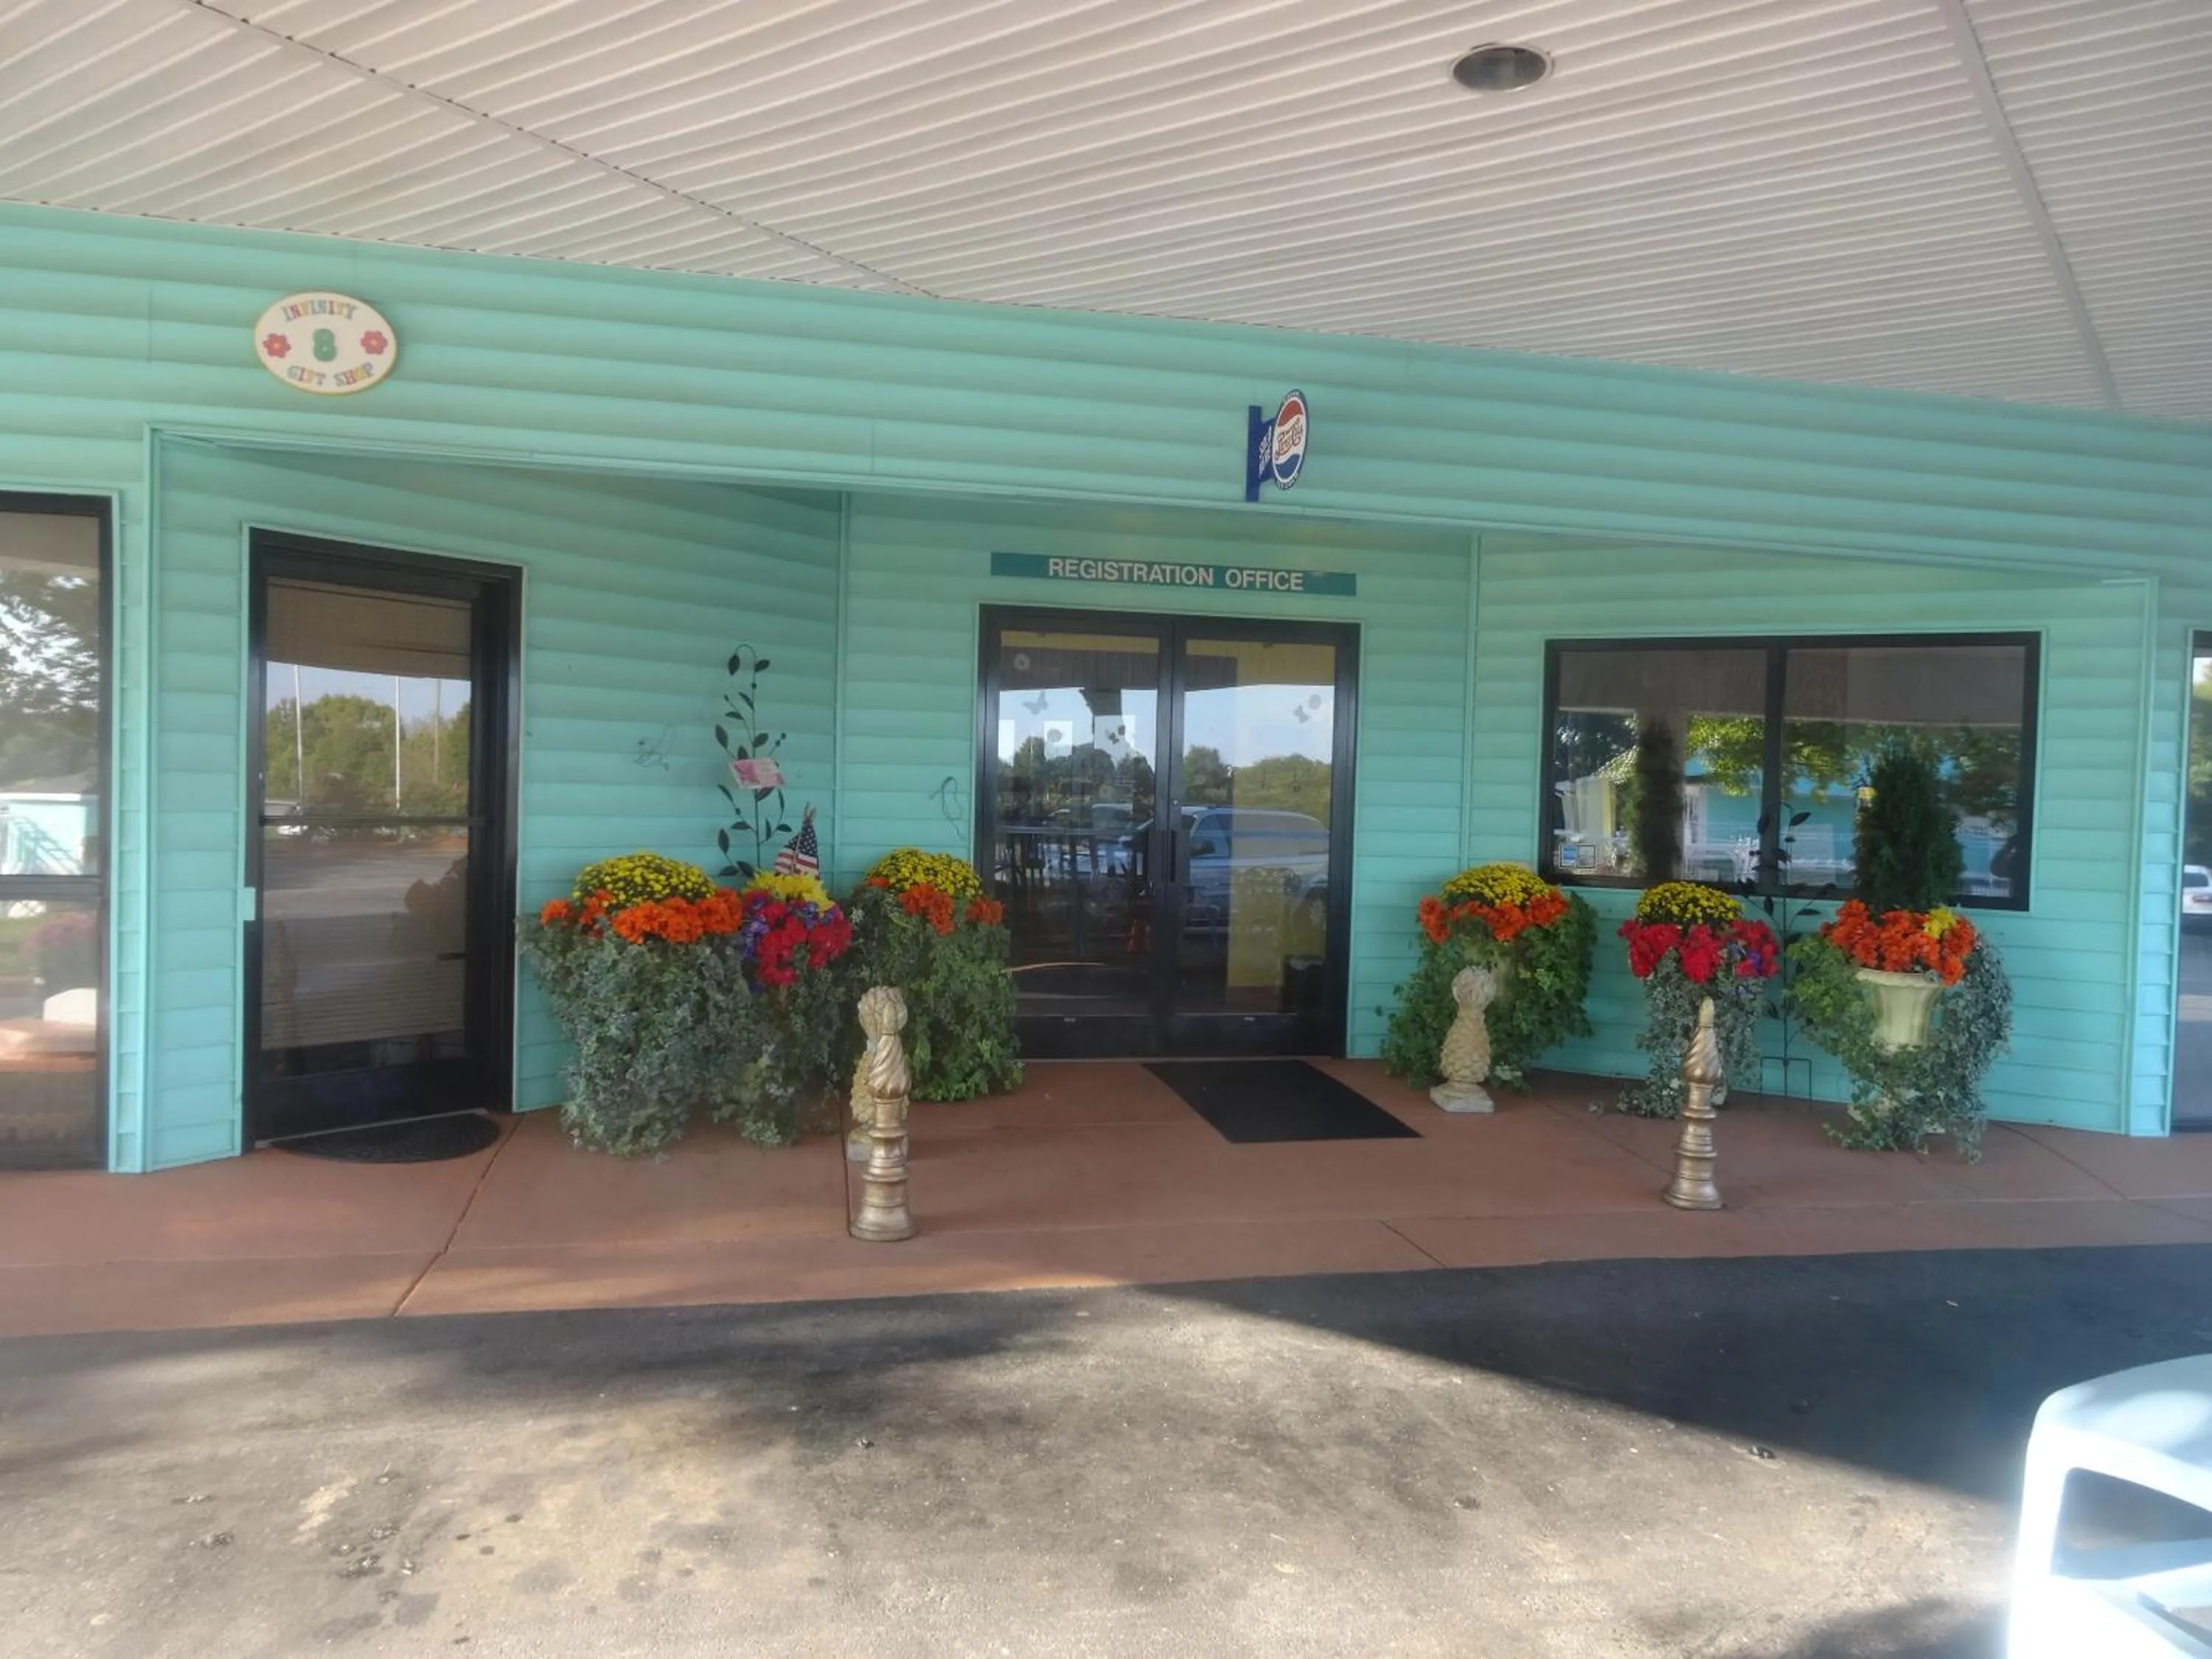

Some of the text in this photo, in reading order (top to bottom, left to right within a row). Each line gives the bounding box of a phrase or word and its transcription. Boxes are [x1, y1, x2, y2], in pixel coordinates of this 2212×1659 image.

[282, 299, 358, 321] INFINITY
[287, 362, 374, 387] GIFT SHOP
[1048, 557, 1304, 591] REGISTRATION OFFICE
